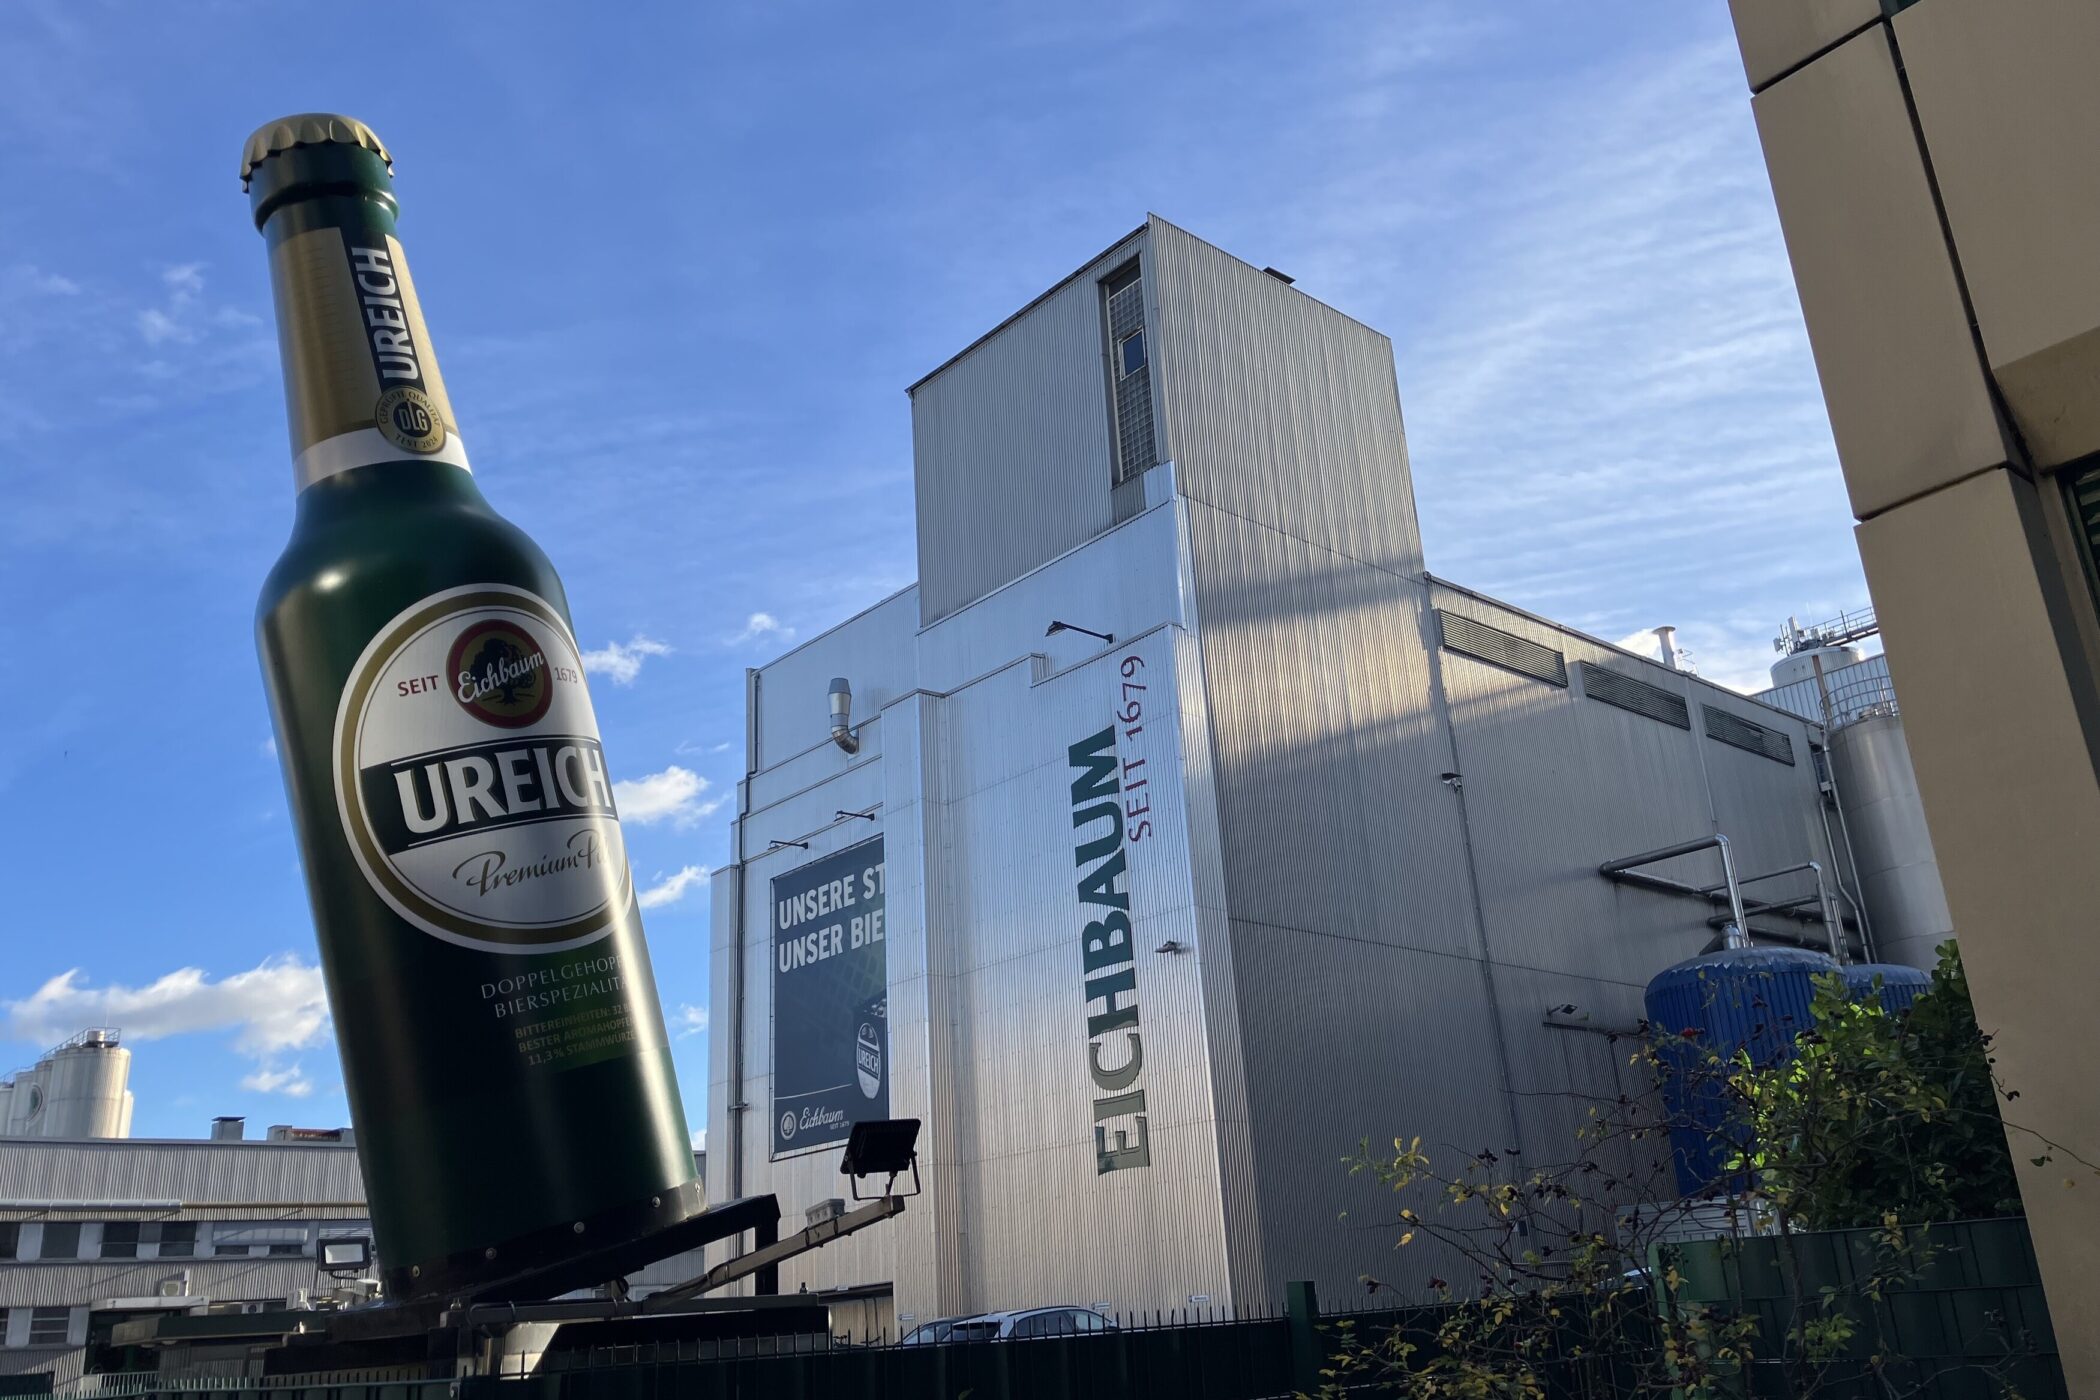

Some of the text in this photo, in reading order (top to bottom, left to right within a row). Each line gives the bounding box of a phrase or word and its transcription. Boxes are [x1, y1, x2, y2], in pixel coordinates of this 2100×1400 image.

[351, 247, 418, 381] UREICH
[398, 401, 429, 431] DLG
[397, 667, 578, 697] SEIT 1679
[457, 651, 544, 703] Eichbaum
[1117, 655, 1152, 842] SEIT 1679
[394, 746, 612, 834] UREICH
[452, 850, 578, 897] Premium
[779, 874, 855, 930] UNSERE
[779, 924, 843, 973] UNSER
[1068, 724, 1150, 1176] EICHBAUM
[518, 1034, 560, 1053] BESTER
[800, 1106, 844, 1130] Eichbaum
